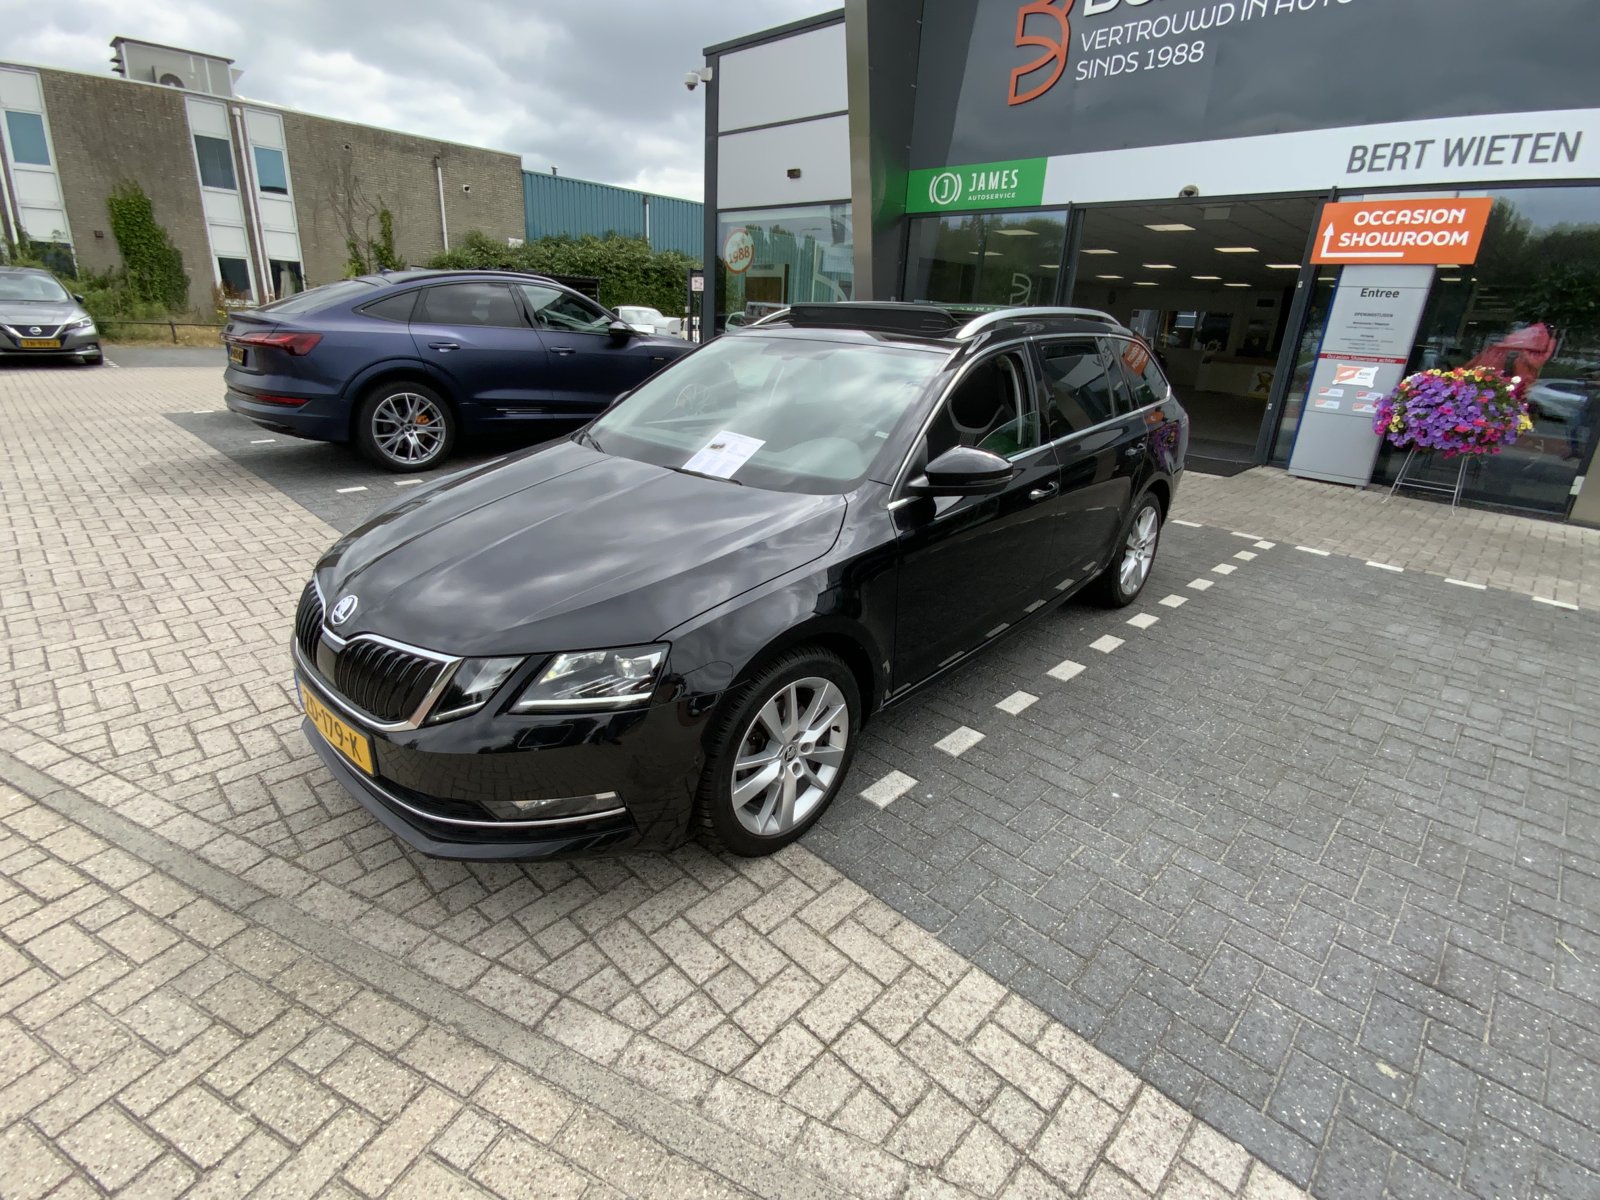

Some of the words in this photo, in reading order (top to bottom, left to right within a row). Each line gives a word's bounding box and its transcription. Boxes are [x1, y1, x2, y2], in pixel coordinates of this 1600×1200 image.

[1081, 3, 1235, 52] VERTROUWD
[1240, 0, 1268, 22] IN
[1075, 51, 1140, 81] SINDS
[1143, 40, 1205, 70] 1988
[1346, 139, 1435, 174] BERT
[1443, 131, 1583, 167] WIETEN
[968, 169, 1019, 192] JAMES
[967, 192, 1016, 201] AUTOSERVICE
[1353, 208, 1466, 226] OCCASION
[1338, 230, 1469, 247] SHOWROOM
[1360, 287, 1400, 299] Entree
